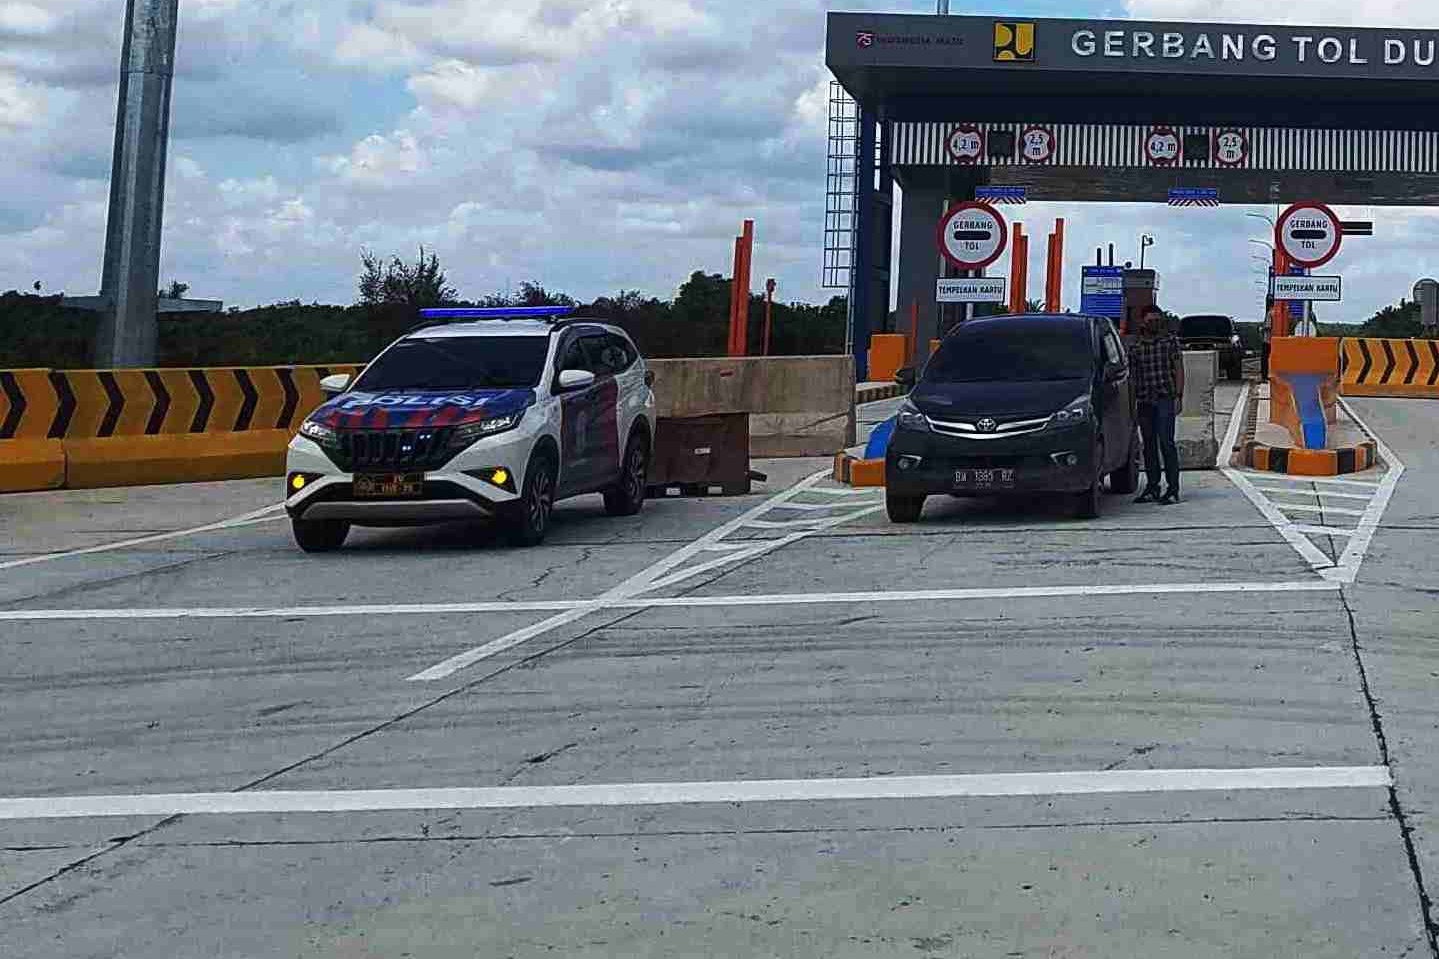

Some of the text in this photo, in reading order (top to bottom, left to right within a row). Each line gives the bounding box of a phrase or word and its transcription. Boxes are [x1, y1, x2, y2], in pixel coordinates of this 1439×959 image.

[1071, 29, 1277, 61] GERBANG
[1292, 36, 1368, 64] TOL
[953, 220, 993, 230] GERBANG
[341, 391, 489, 408] POLISI
